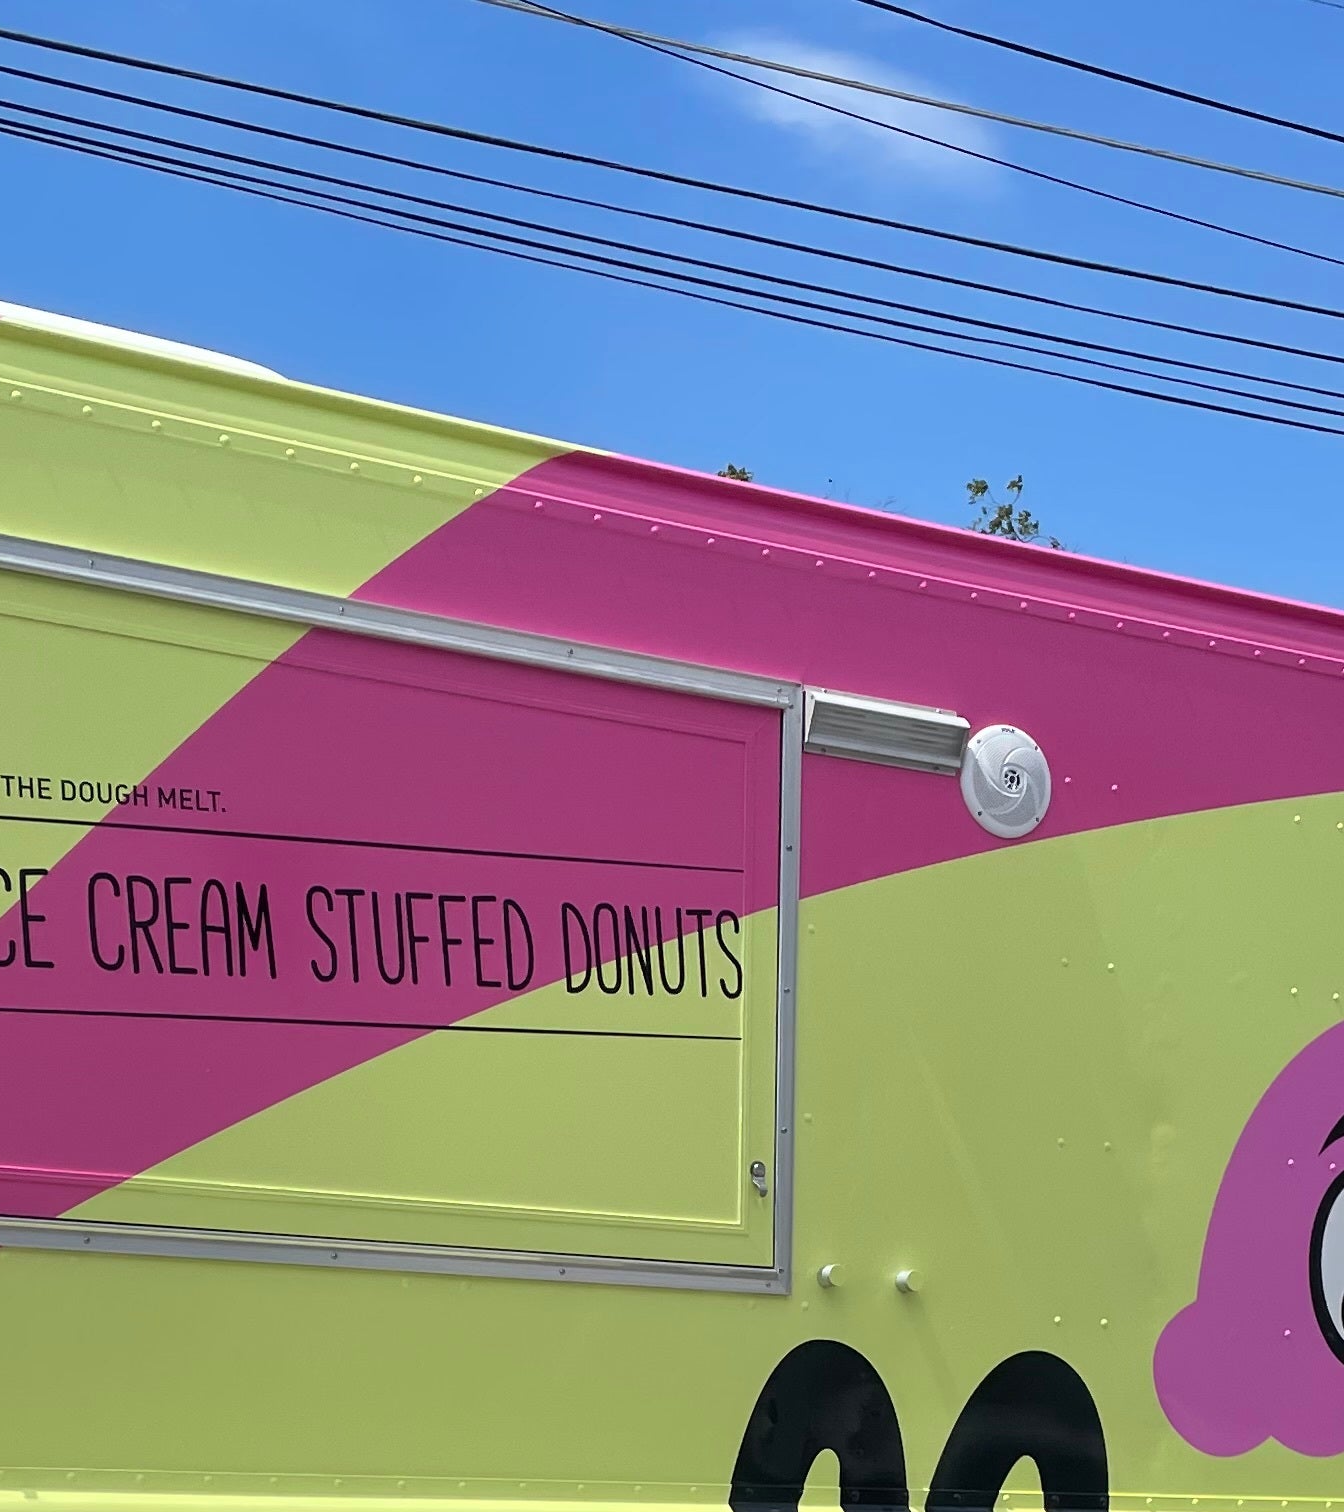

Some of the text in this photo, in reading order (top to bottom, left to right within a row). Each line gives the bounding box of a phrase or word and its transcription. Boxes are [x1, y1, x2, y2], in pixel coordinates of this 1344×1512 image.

[0, 774, 53, 801] THE
[60, 779, 149, 808] DOUGH
[156, 786, 227, 813] MELT.
[87, 871, 278, 981] CREAM
[305, 885, 535, 992] STUFFED
[561, 902, 743, 1000] DONUTS
